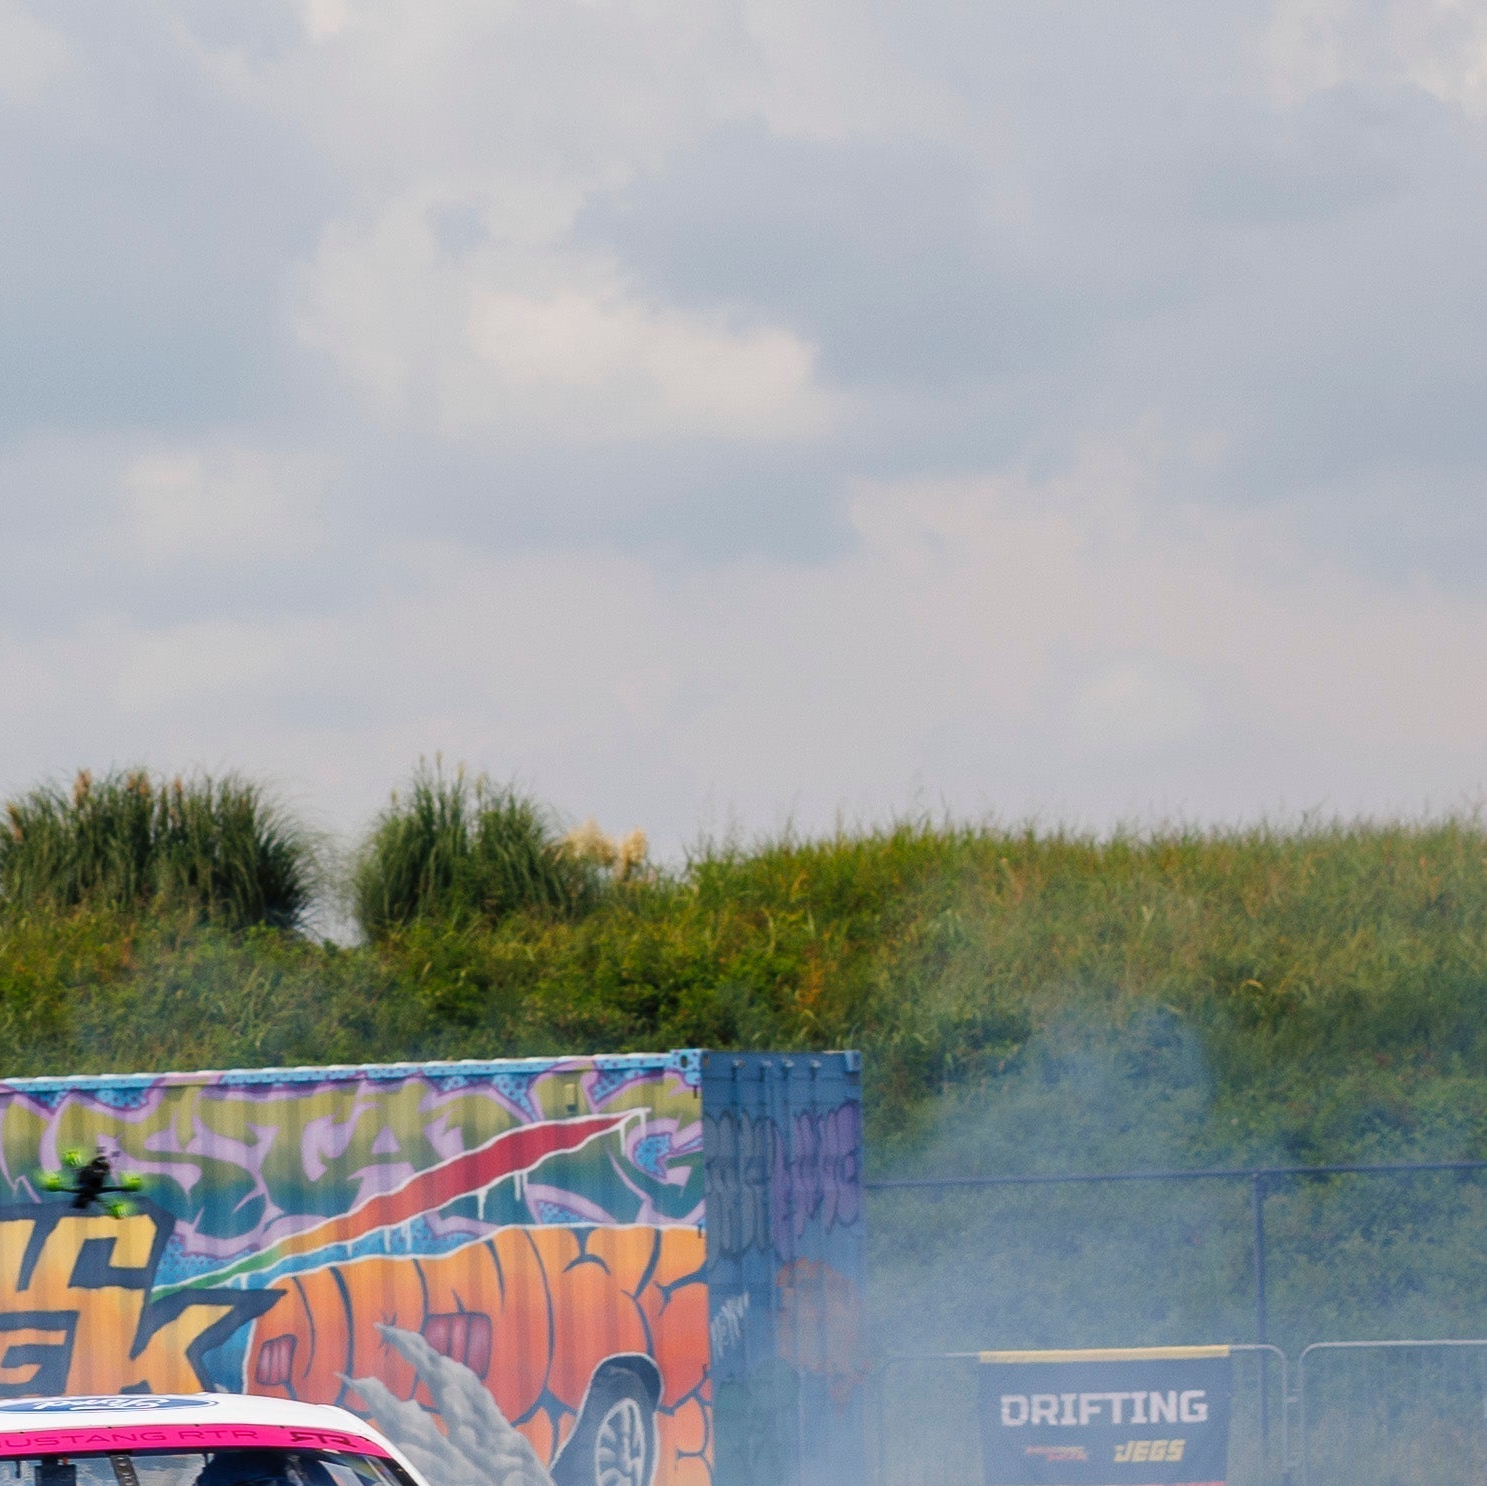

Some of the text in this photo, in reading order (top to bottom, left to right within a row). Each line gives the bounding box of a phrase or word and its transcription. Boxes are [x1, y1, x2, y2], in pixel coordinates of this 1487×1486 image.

[1000, 1390, 1208, 1427] DRIFTING
[179, 1429, 260, 1441] RTR
[1114, 1438, 1186, 1463] JEGS
